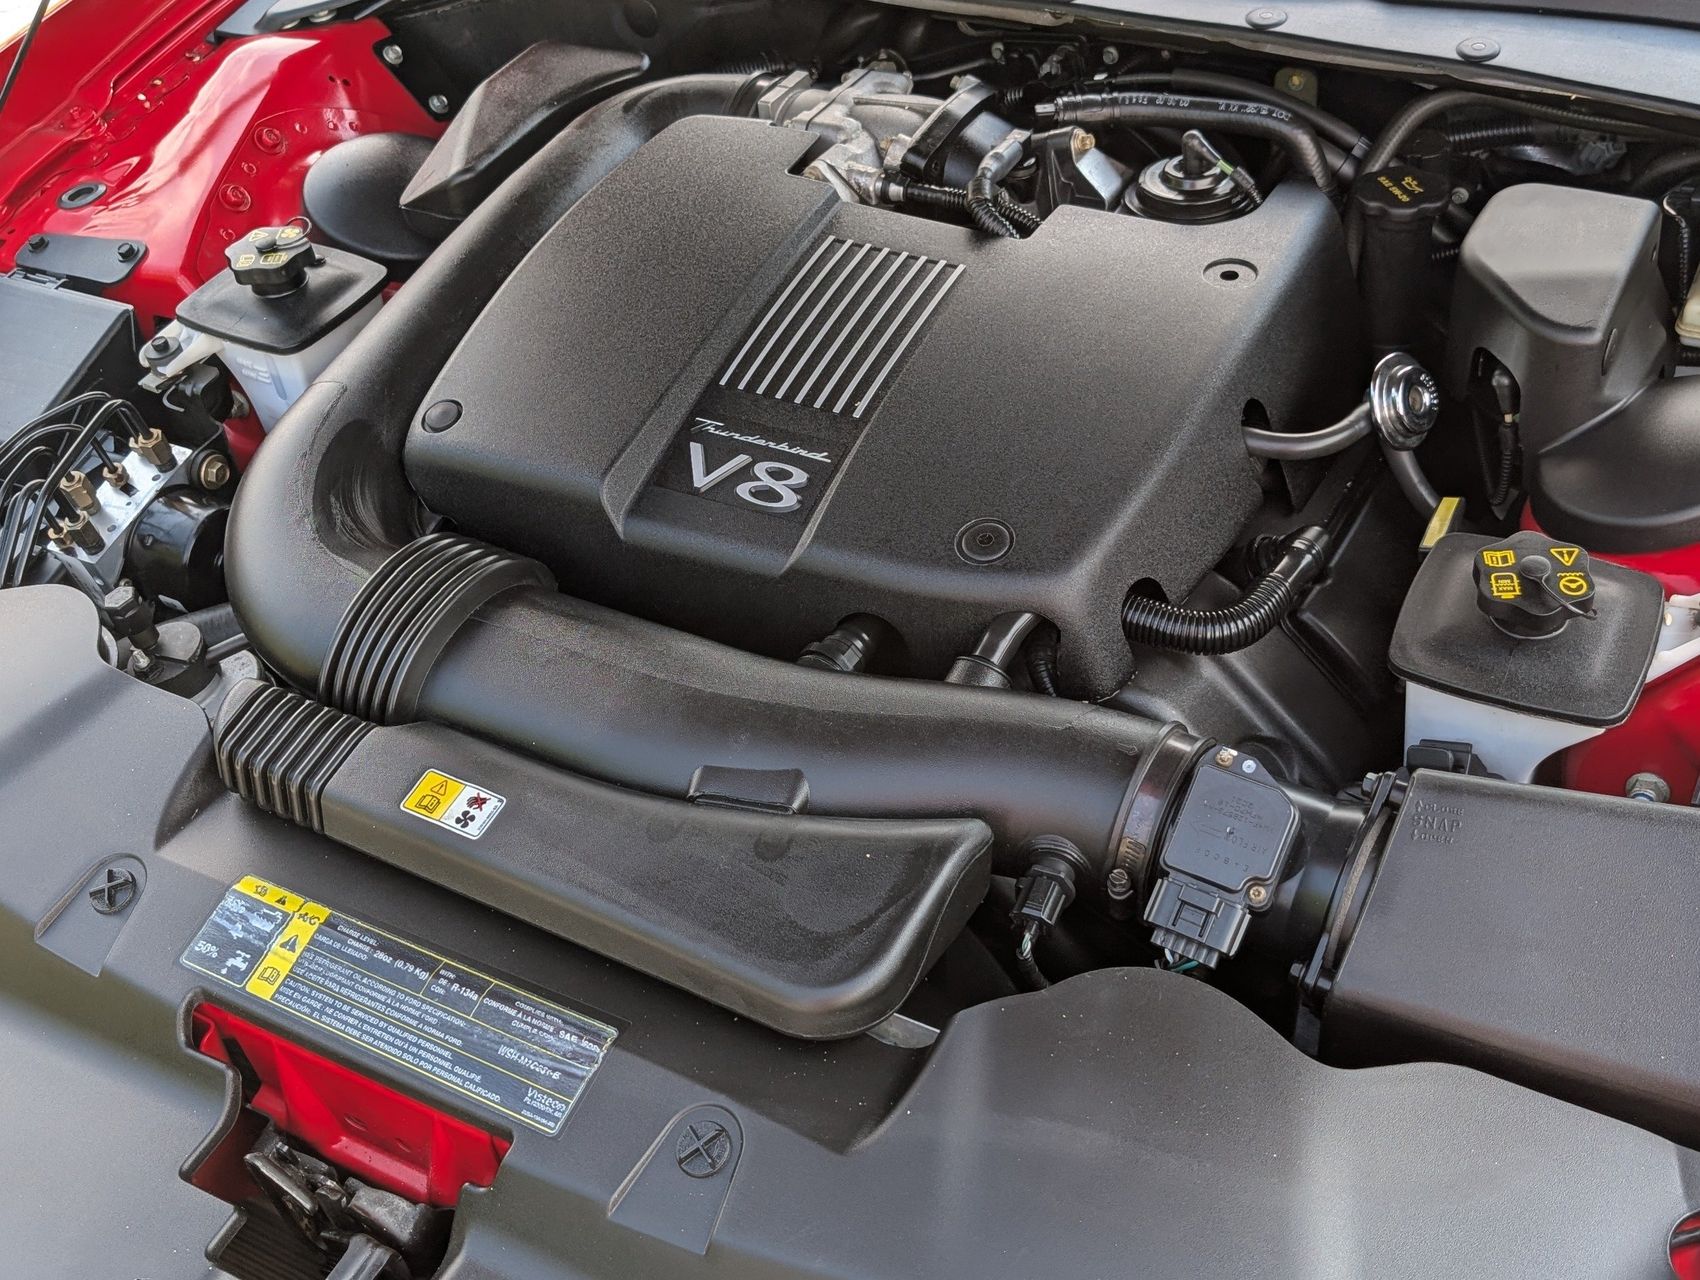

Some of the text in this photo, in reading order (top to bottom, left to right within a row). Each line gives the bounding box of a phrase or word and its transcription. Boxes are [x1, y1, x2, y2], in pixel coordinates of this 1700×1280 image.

[690, 417, 832, 463] Thunderbird
[690, 441, 810, 513] V8
[1413, 815, 1462, 832] SNAP
[194, 940, 219, 958] 50%
[314, 933, 333, 946] CARGA
[333, 942, 341, 950] DE
[338, 925, 380, 946] CHARGE LEVEL:
[373, 950, 393, 963] 28oz
[394, 958, 414, 972] (0.79
[414, 968, 429, 980] Kg)
[315, 956, 353, 977] REFRIGERANT
[352, 972, 362, 982] OIL
[362, 977, 397, 996] ACCORDING
[396, 992, 406, 1000] TO
[405, 996, 422, 1008] FORD
[420, 1002, 466, 1028] SPECIFICATION:
[354, 983, 388, 1002] CONFORME
[391, 1000, 400, 1008] LA
[400, 1004, 422, 1018] NORME
[450, 982, 478, 1001] R-134a
[293, 992, 302, 1000] EN
[324, 1006, 334, 1015] NE
[334, 1010, 358, 1026] CONFIER
[408, 1044, 418, 1054] UN
[418, 1048, 453, 1070] PERSONNEL
[311, 990, 334, 1004] SYSTEM
[334, 1000, 342, 1008] TO
[342, 1004, 352, 1012] BE
[350, 1008, 380, 1025] SERVICED
[378, 1020, 388, 1029] BY
[387, 1025, 418, 1043] QUALIFIED
[324, 979, 340, 992] PARA
[340, 986, 386, 1012] REFRIGERANTES
[384, 1008, 420, 1027] CONFORME
[423, 1024, 445, 1038] NORMA
[444, 1035, 464, 1048] FORD:
[483, 998, 518, 1017] CONFORME
[523, 1014, 532, 1024] LA
[558, 1030, 579, 1044] SAE
[312, 1010, 320, 1020] EL
[320, 1014, 346, 1030] SISTEMA
[344, 1026, 362, 1038] DEBE
[361, 1033, 374, 1044] SER
[372, 1040, 402, 1057] ATENDIDO
[402, 1052, 420, 1064] SOLO
[418, 1060, 434, 1072] POR
[432, 1066, 464, 1086] PERSONAL
[527, 1086, 567, 1112] Visteon
